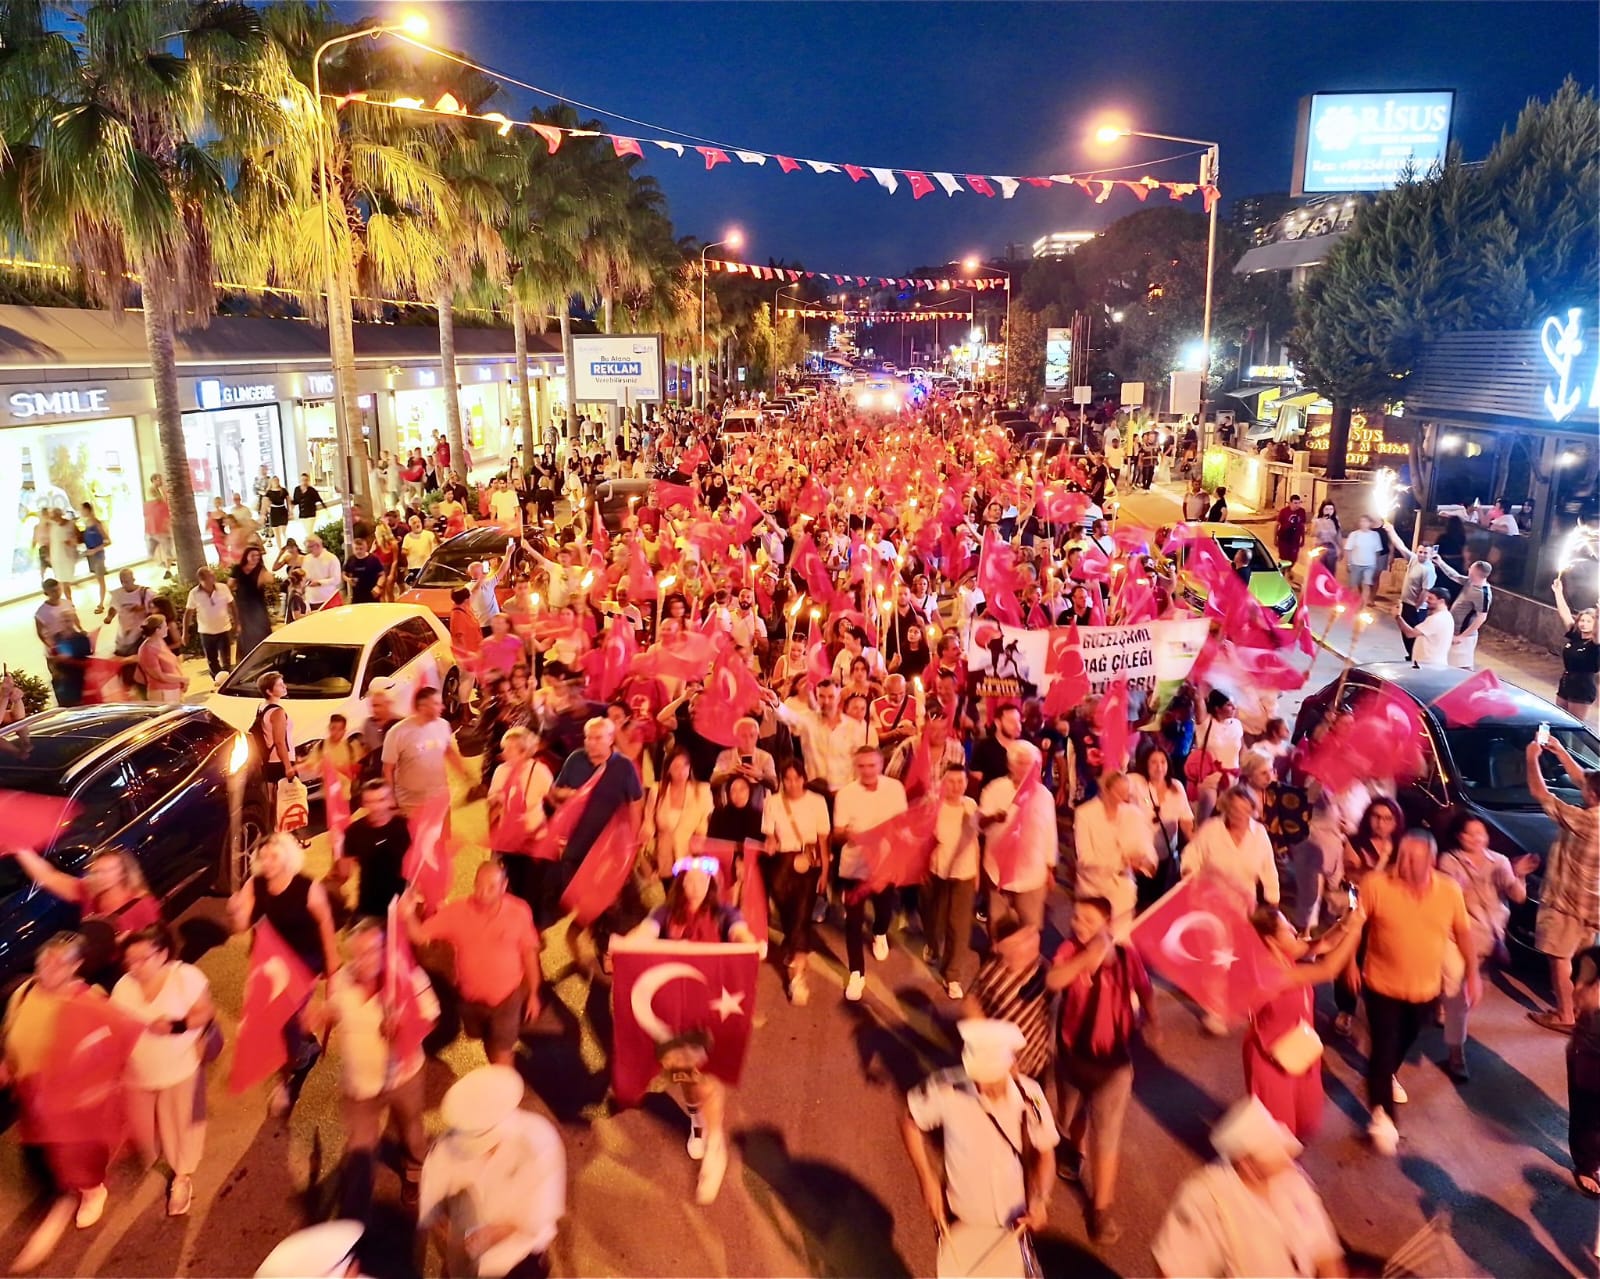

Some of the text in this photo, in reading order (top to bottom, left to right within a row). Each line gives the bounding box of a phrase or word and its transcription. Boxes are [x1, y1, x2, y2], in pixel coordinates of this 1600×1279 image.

[1360, 100, 1447, 132] RİSUS
[593, 363, 639, 374] REKLAM
[10, 389, 110, 418] SMILE
